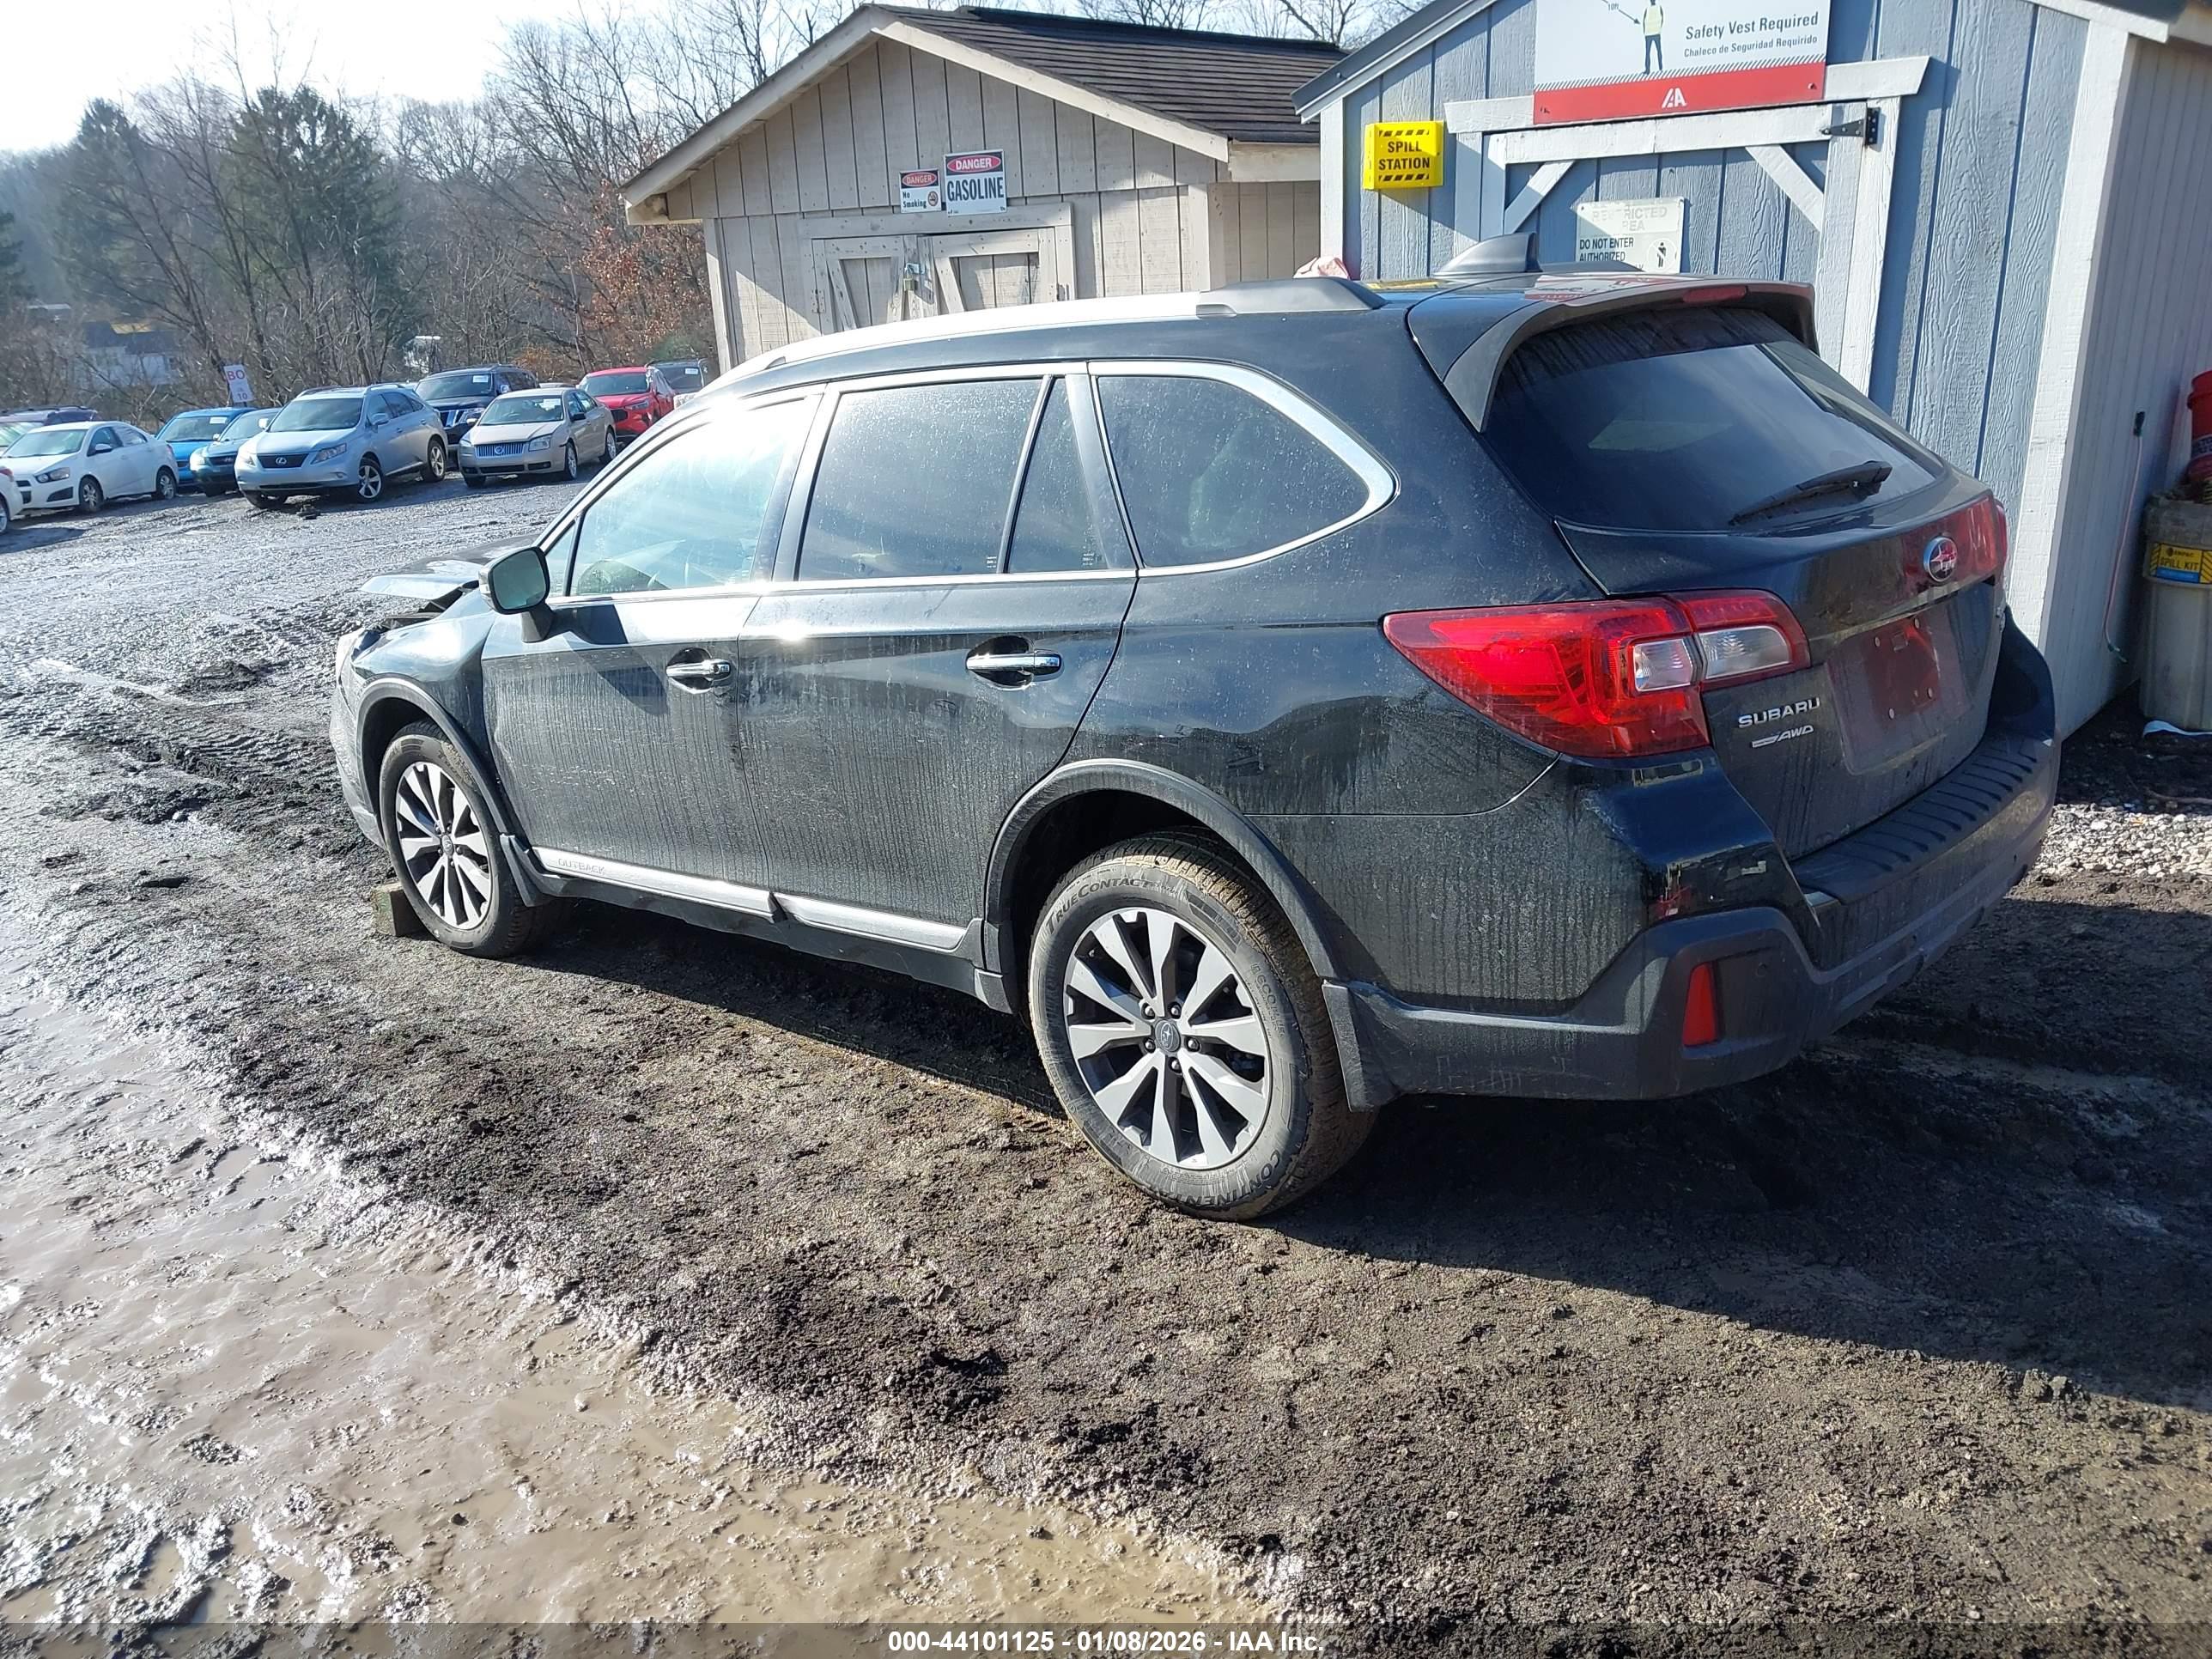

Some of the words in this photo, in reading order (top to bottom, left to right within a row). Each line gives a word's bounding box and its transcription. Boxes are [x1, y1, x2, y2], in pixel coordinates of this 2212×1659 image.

[1686, 25, 1724, 40] Safety
[1729, 20, 1755, 34] Vest
[1759, 11, 1819, 33] Required
[1684, 48, 1717, 58] Chaleco
[1719, 45, 1729, 53] de
[1731, 39, 1773, 53] Seguridad
[1776, 34, 1818, 48] Requirido
[1388, 141, 1422, 153] SPILL
[955, 158, 992, 170] DANGER
[1378, 157, 1430, 170] STATION
[906, 174, 932, 184] DANGER
[946, 177, 1004, 202] GASOLINE
[902, 200, 927, 209] Smoking
[1579, 239, 1590, 250] DO
[1592, 238, 1607, 249] NOT
[1609, 237, 1634, 248] ENTER
[1579, 252, 1626, 262] AUTHORIZED
[1738, 696, 1820, 728] SUBARU
[1778, 725, 1814, 741] AWD
[558, 858, 605, 874] OUTBACK
